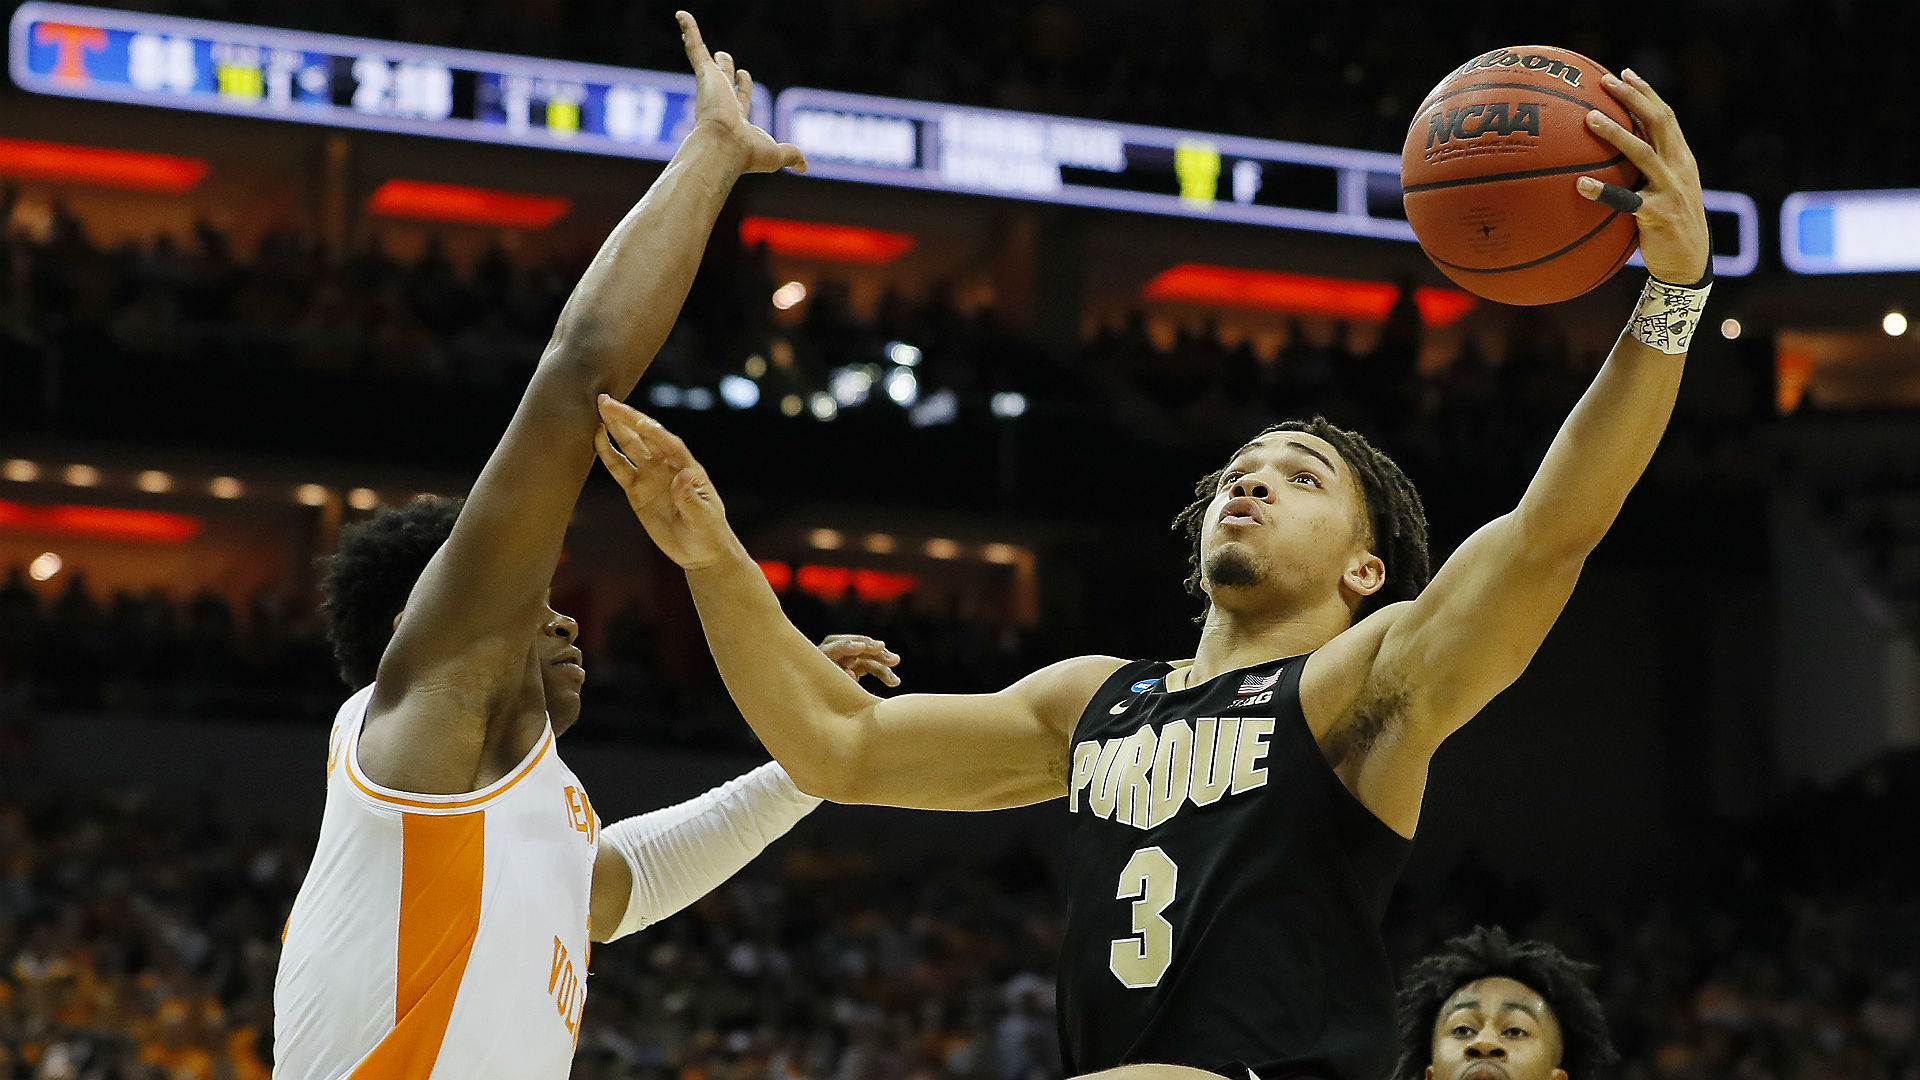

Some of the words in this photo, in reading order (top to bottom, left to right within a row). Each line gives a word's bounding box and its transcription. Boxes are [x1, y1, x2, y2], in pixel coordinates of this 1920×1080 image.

[1445, 48, 1583, 88] ilson
[1425, 102, 1540, 151] NCAA
[1069, 717, 1276, 830] PURDUE
[1109, 846, 1179, 989] 3
[548, 934, 585, 1056] VOL
